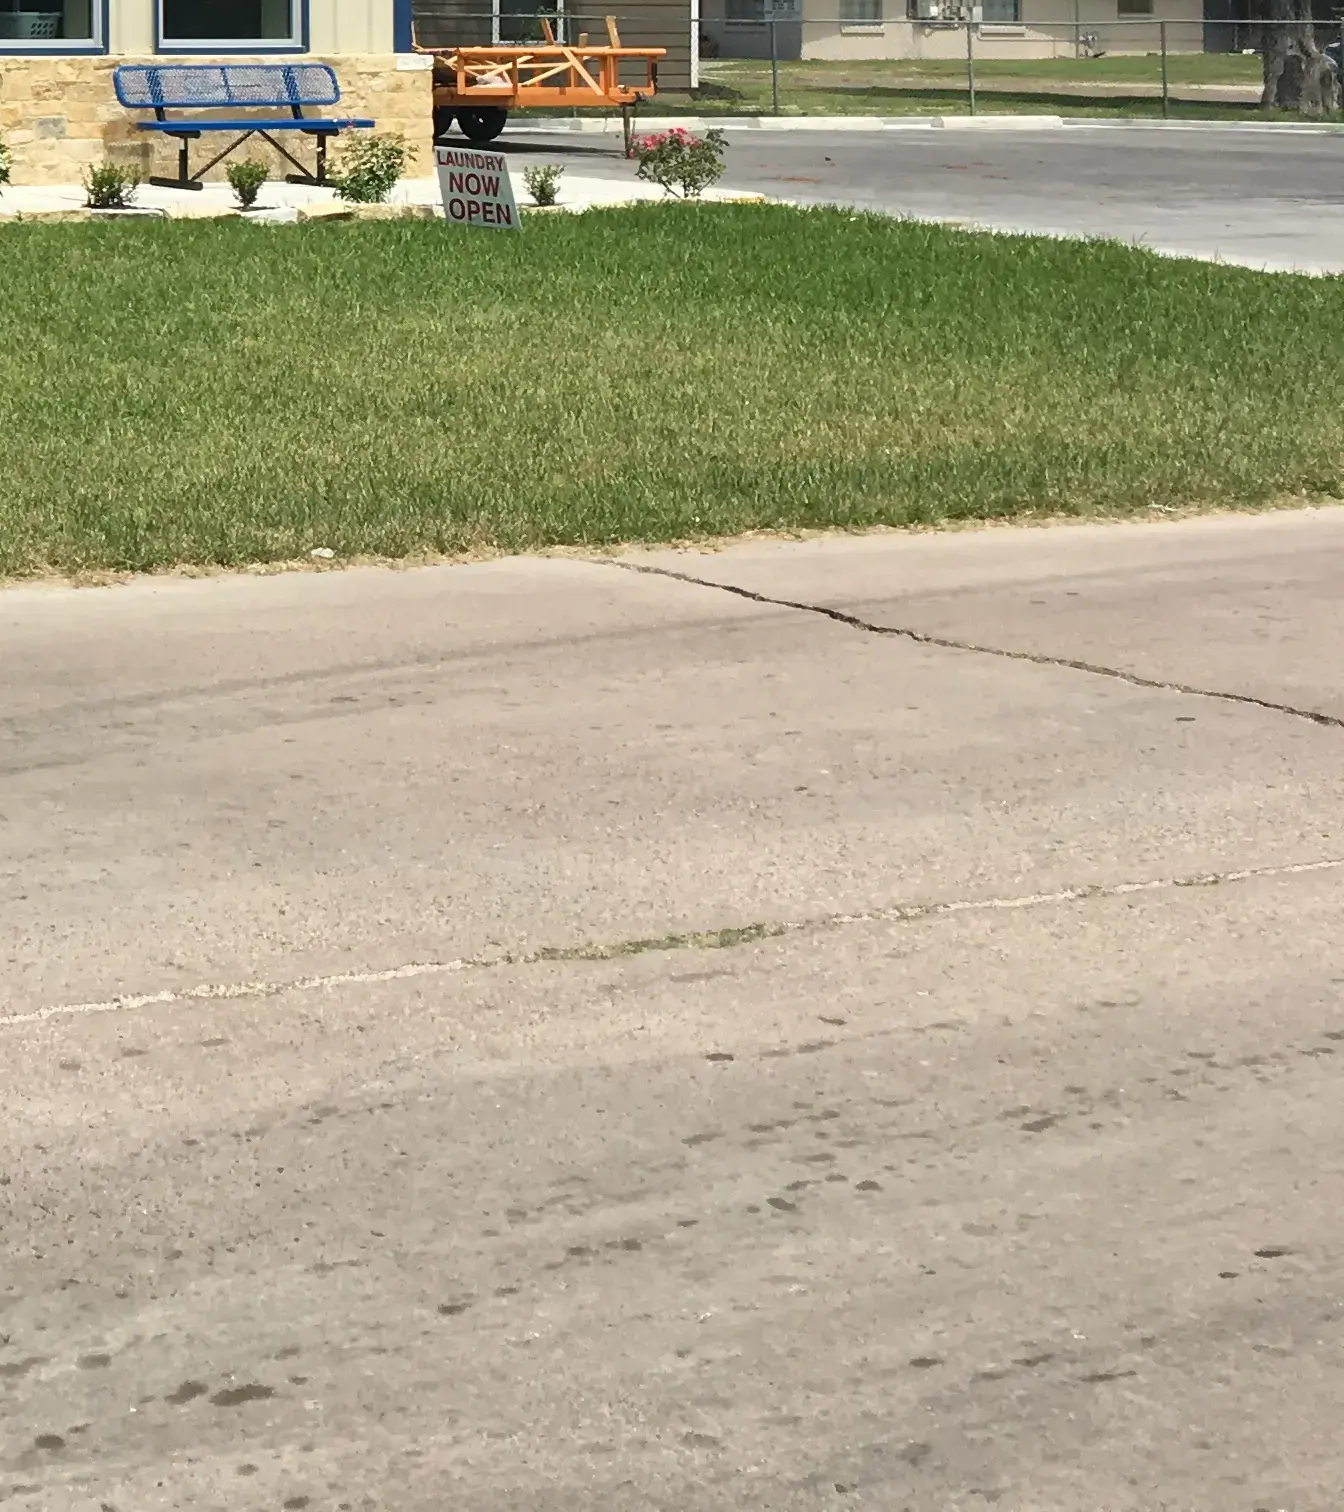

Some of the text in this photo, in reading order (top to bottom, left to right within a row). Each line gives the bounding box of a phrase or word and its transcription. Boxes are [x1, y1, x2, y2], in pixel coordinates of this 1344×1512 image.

[437, 150, 505, 172] LAUNDRY
[449, 172, 501, 197] NOW
[449, 198, 512, 225] OPEN
